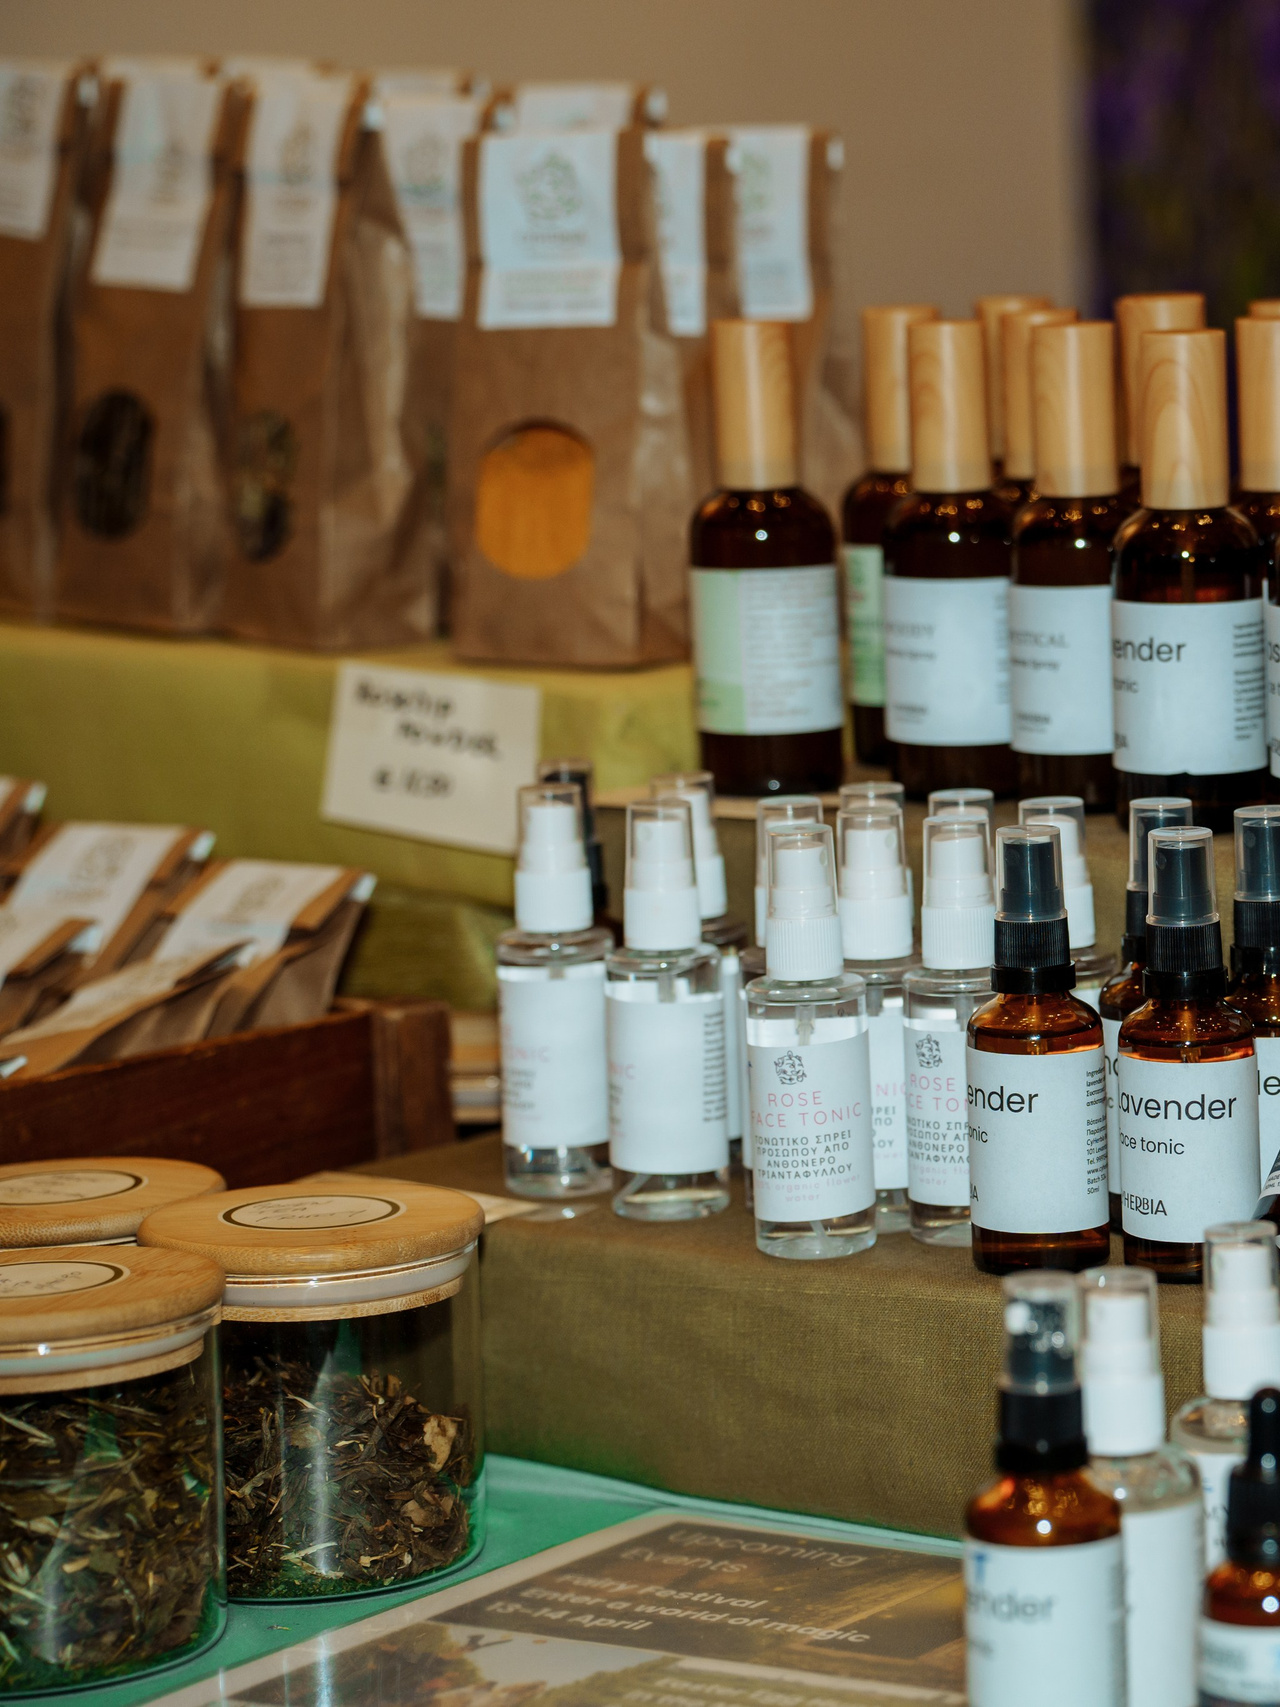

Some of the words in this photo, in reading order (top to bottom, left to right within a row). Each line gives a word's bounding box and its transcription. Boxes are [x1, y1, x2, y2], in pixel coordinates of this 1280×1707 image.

[910, 1073, 956, 1092] ROSE
[767, 1090, 823, 1108] ROSE
[751, 1110, 787, 1128] FACE
[798, 1102, 862, 1126] TONIC
[815, 1129, 851, 1144] ΣΠΡΕΙ
[824, 1141, 849, 1154] ΑΠΟ
[1141, 1137, 1185, 1155] tonic
[766, 1155, 836, 1169] ΑΝΘΟΝΕΡΟ
[668, 1529, 868, 1568] Upcoming
[621, 1547, 747, 1573] Events
[638, 1585, 768, 1609] Festival
[568, 1614, 653, 1631] April
[606, 1601, 632, 1610] a
[634, 1604, 730, 1622] world
[728, 1617, 769, 1627] of
[763, 1621, 871, 1643] magic
